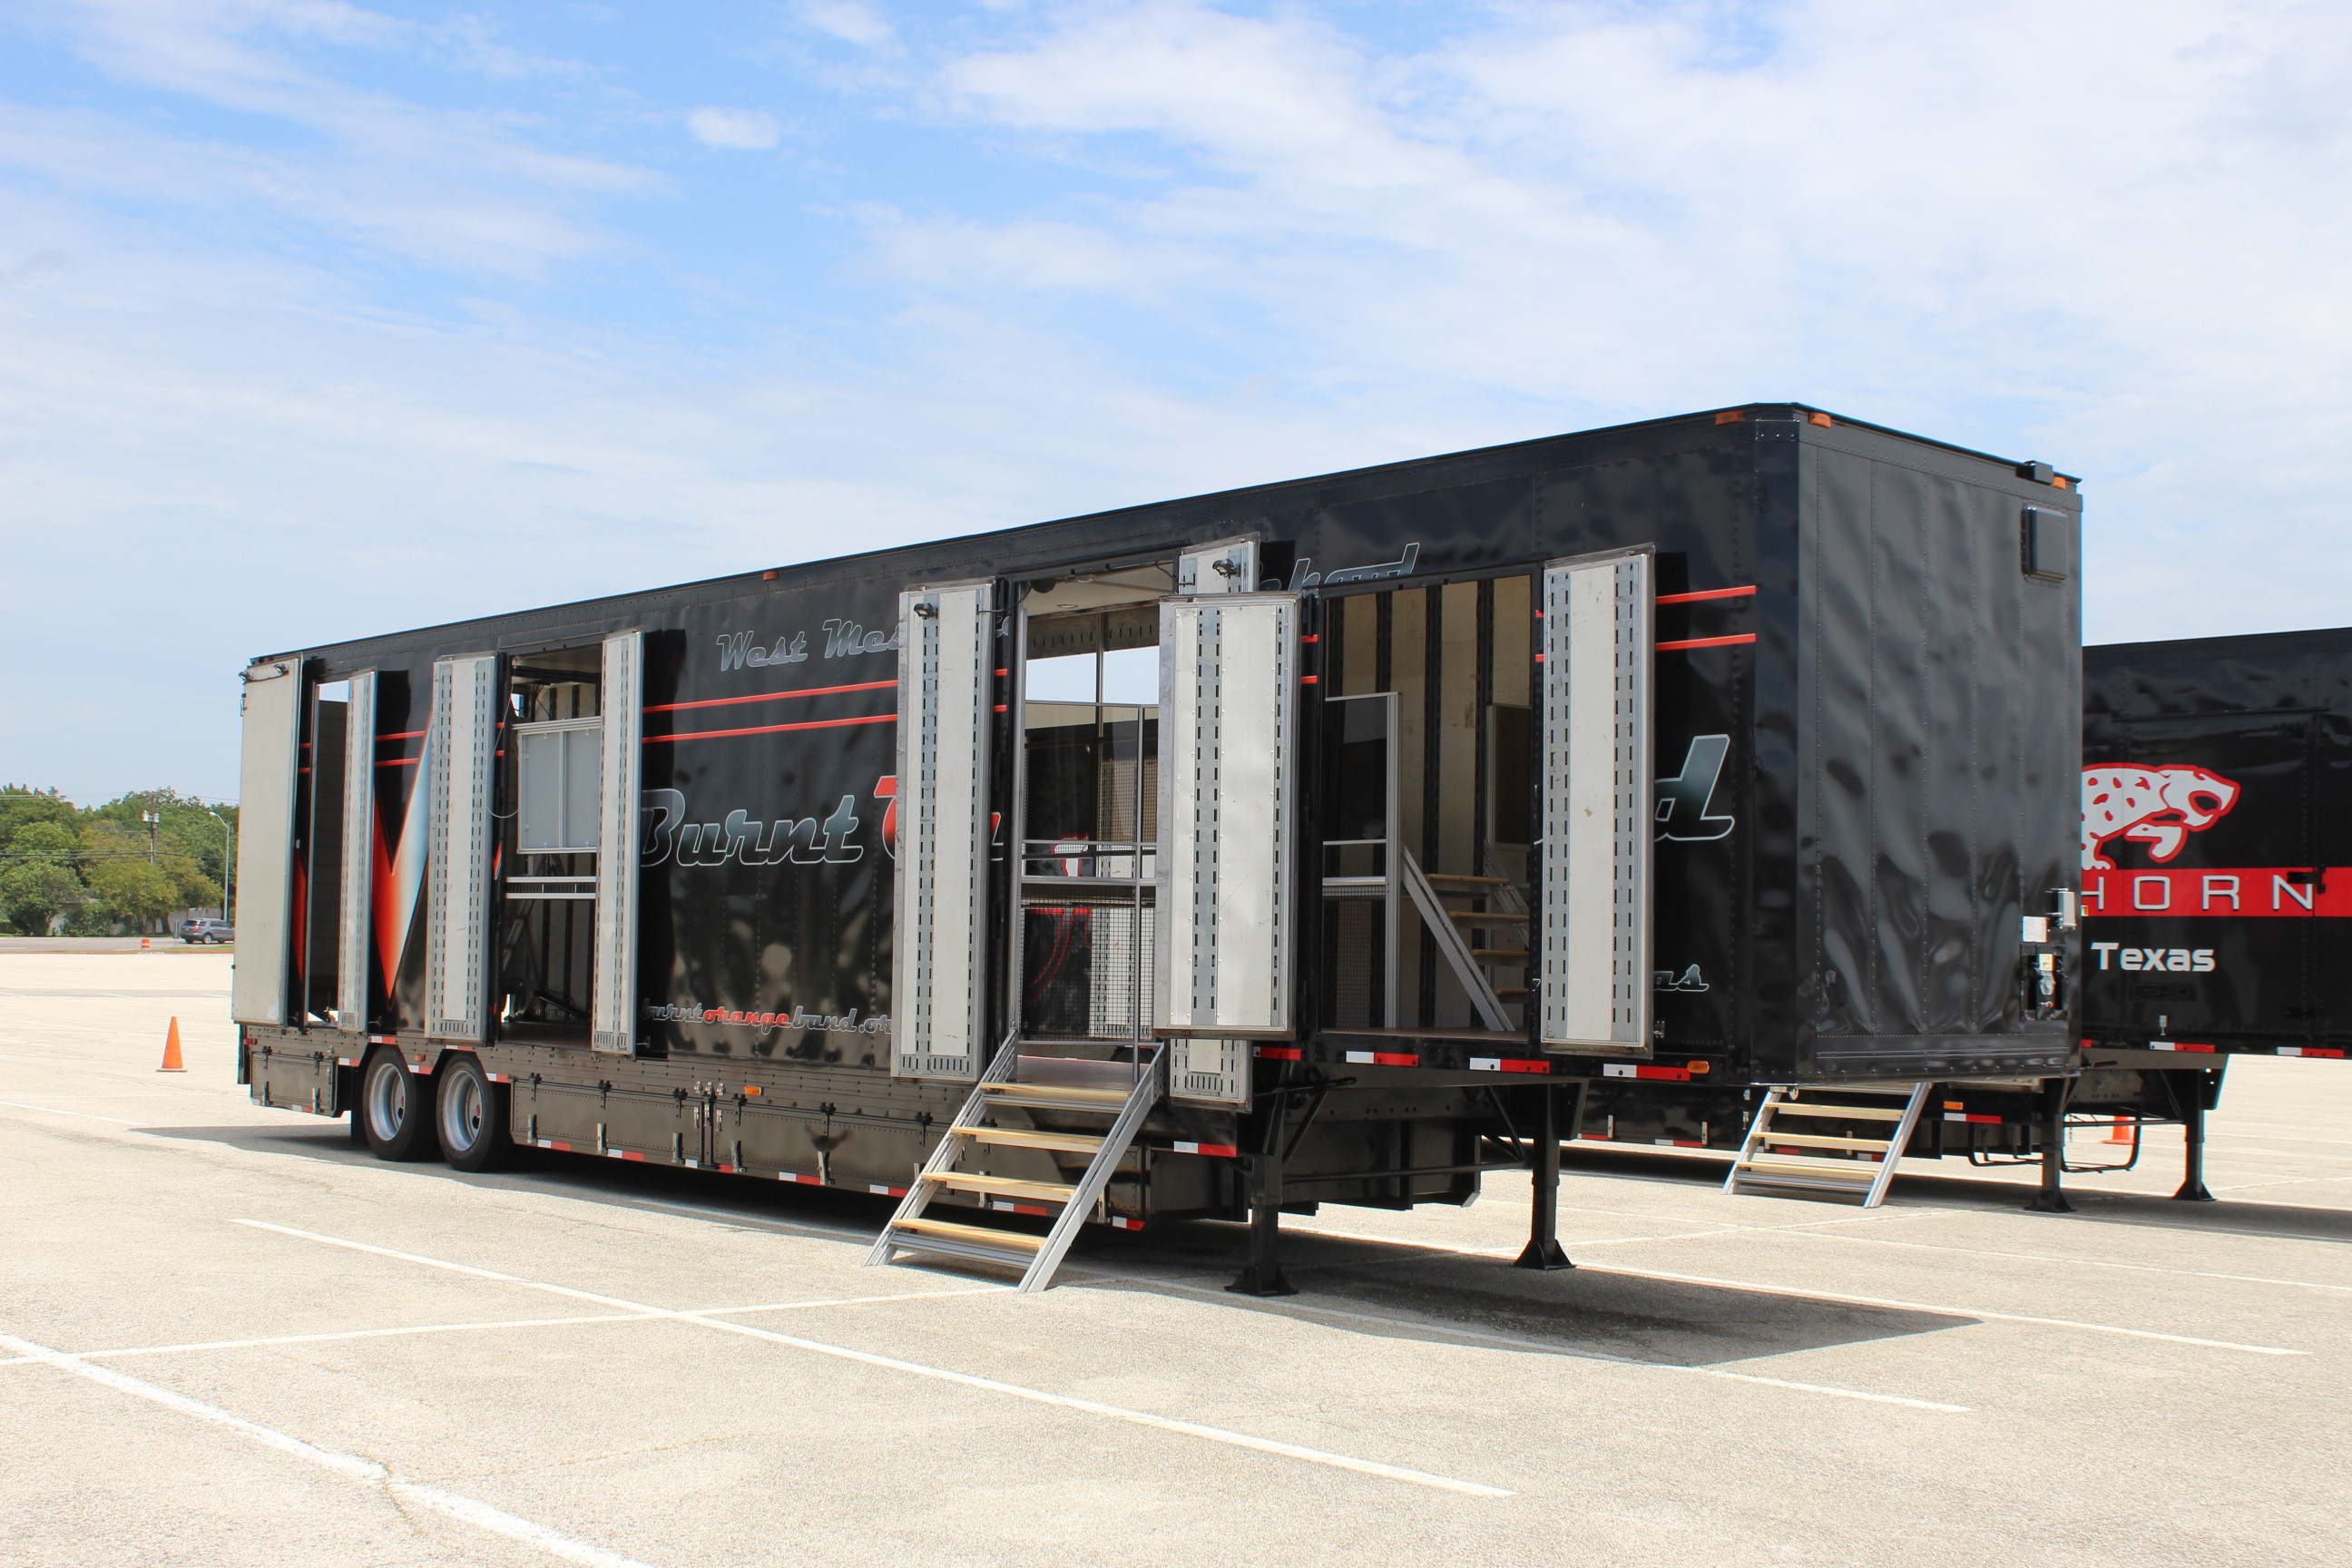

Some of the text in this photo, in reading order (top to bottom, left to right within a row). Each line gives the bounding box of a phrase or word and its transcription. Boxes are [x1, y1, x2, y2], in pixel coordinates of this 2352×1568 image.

[716, 630, 808, 671] West
[641, 788, 864, 867] Burnt
[2090, 942, 2215, 972] Texas
[641, 997, 892, 1034] burntorangeband.or
